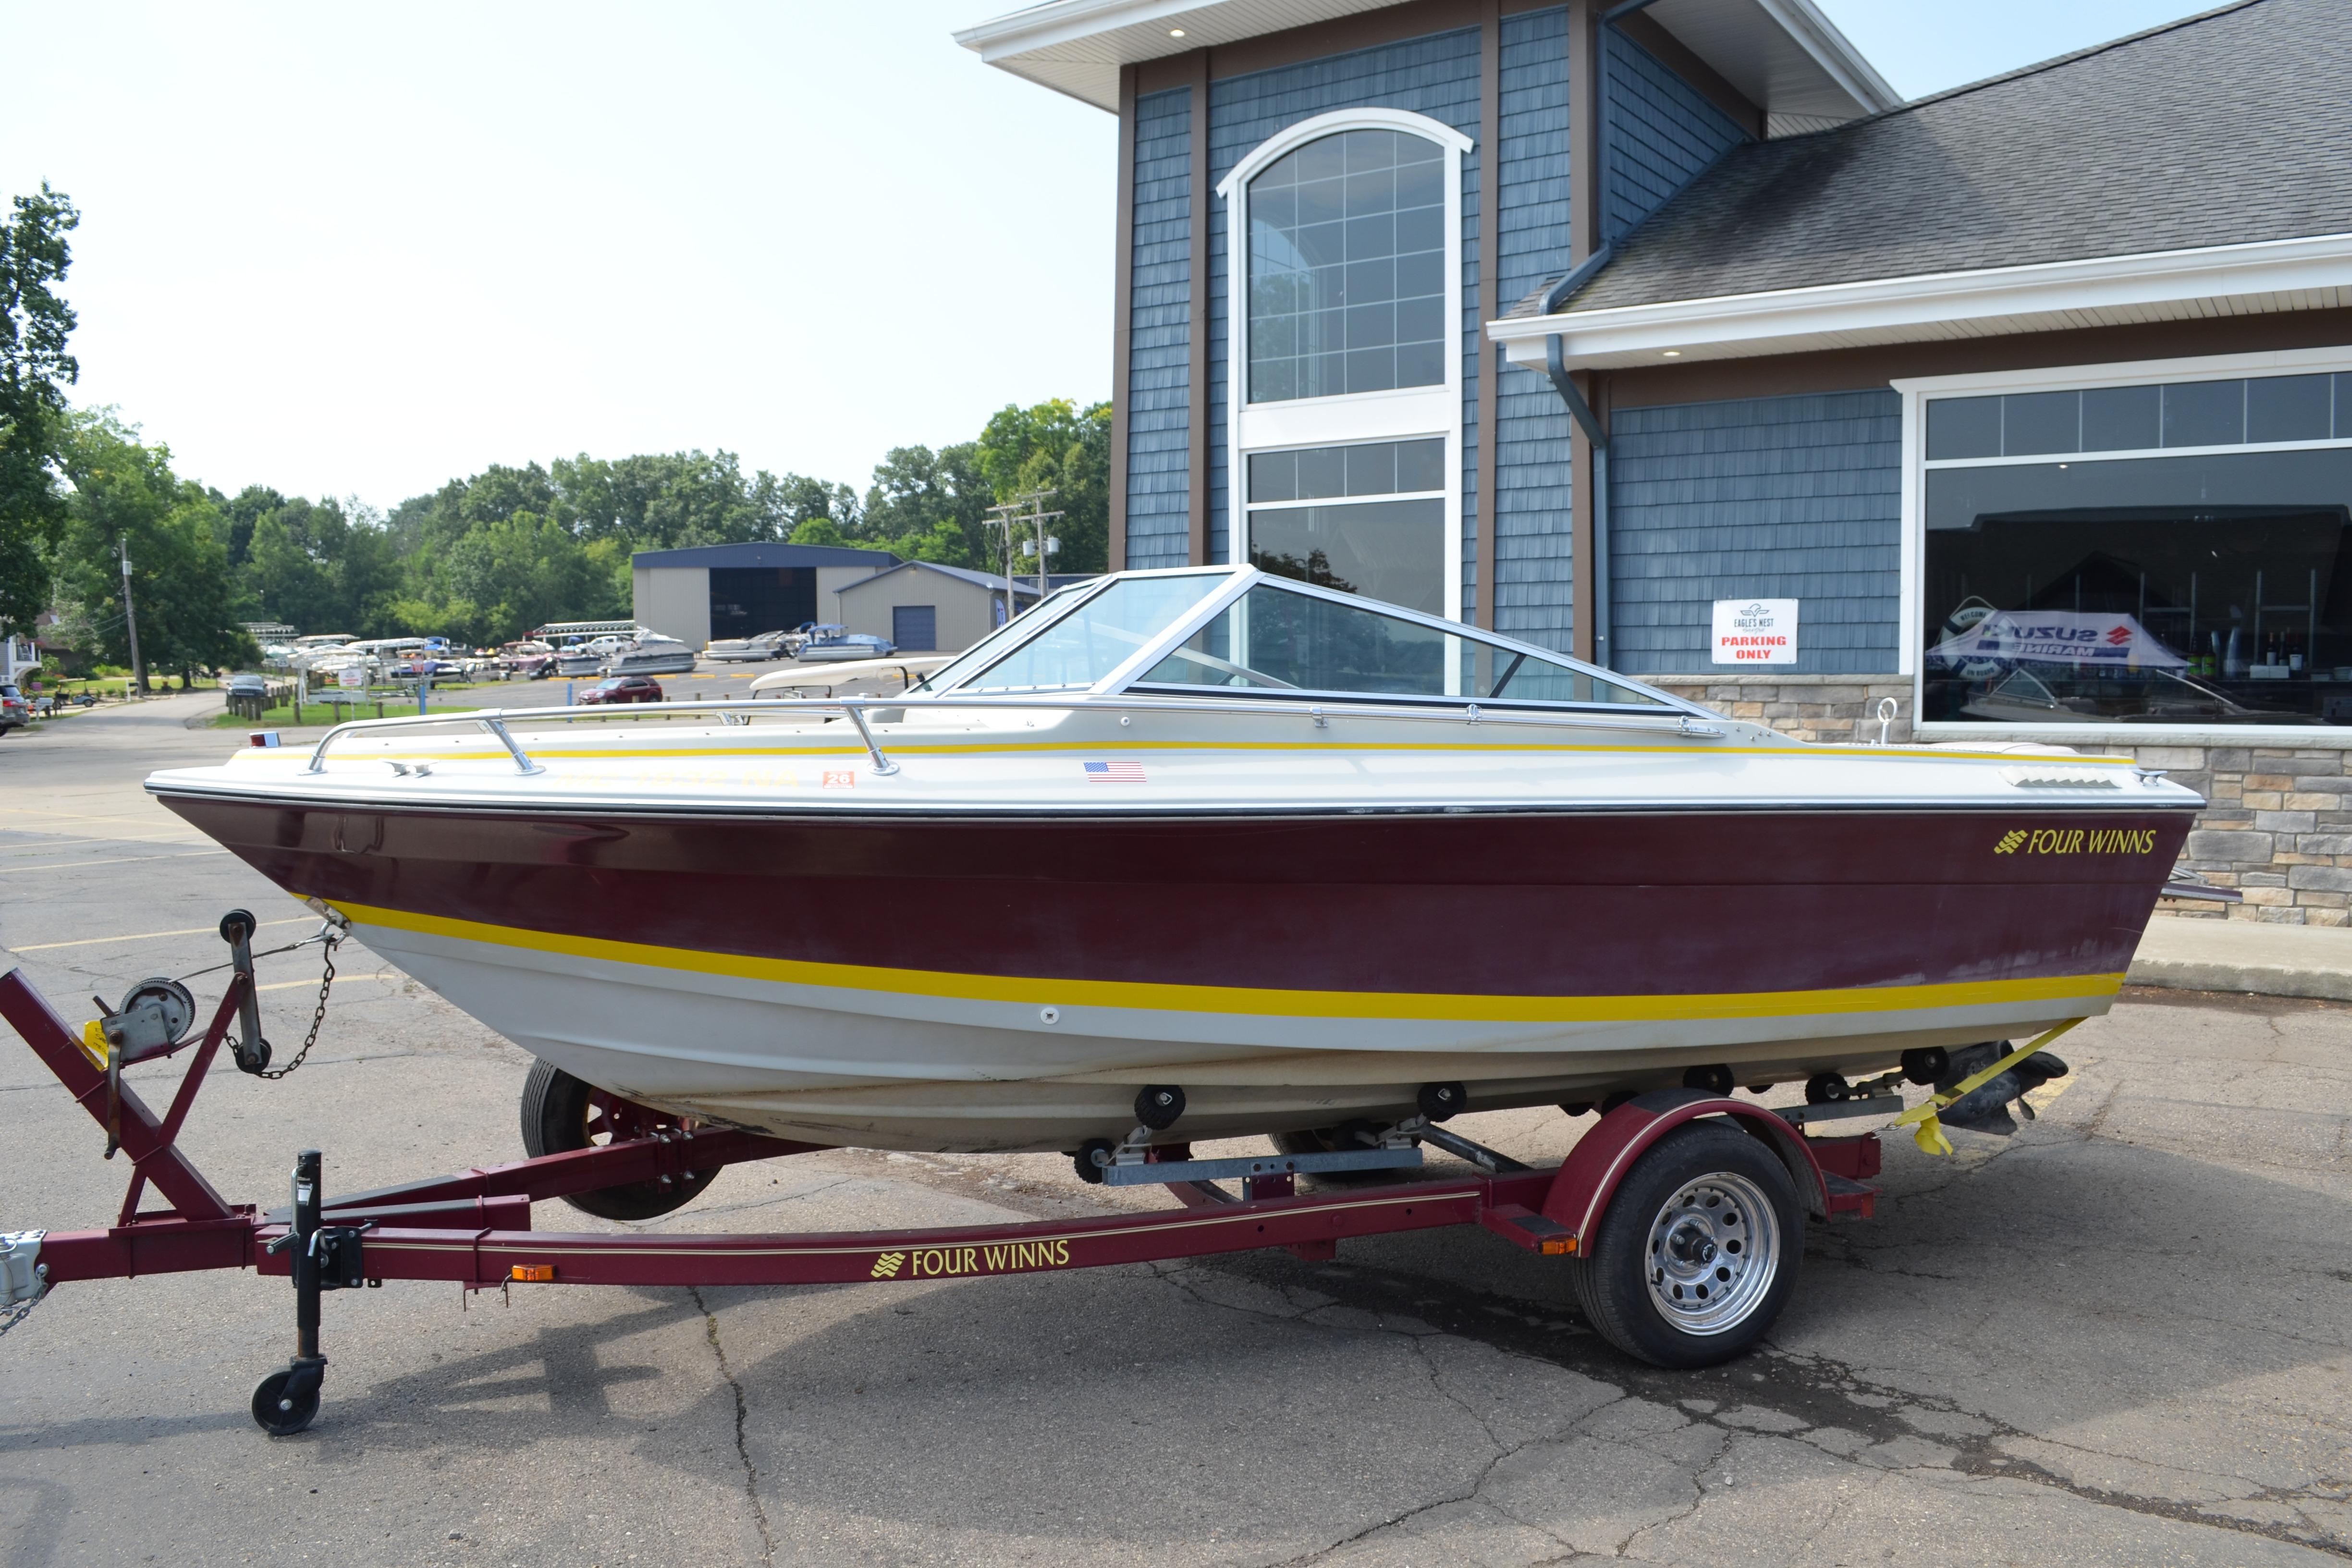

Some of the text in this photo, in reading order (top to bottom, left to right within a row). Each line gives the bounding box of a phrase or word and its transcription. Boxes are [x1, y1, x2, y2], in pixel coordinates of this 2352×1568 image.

[1734, 618, 1774, 627] EAGLE'S NEST
[1722, 636, 1787, 646] PARKING
[1736, 649, 1772, 659] ONLY
[740, 770, 799, 788] NA
[827, 773, 850, 784] 26
[2027, 829, 2156, 854] FOUR WINNS
[912, 1239, 1070, 1276] FOUR WINNS
